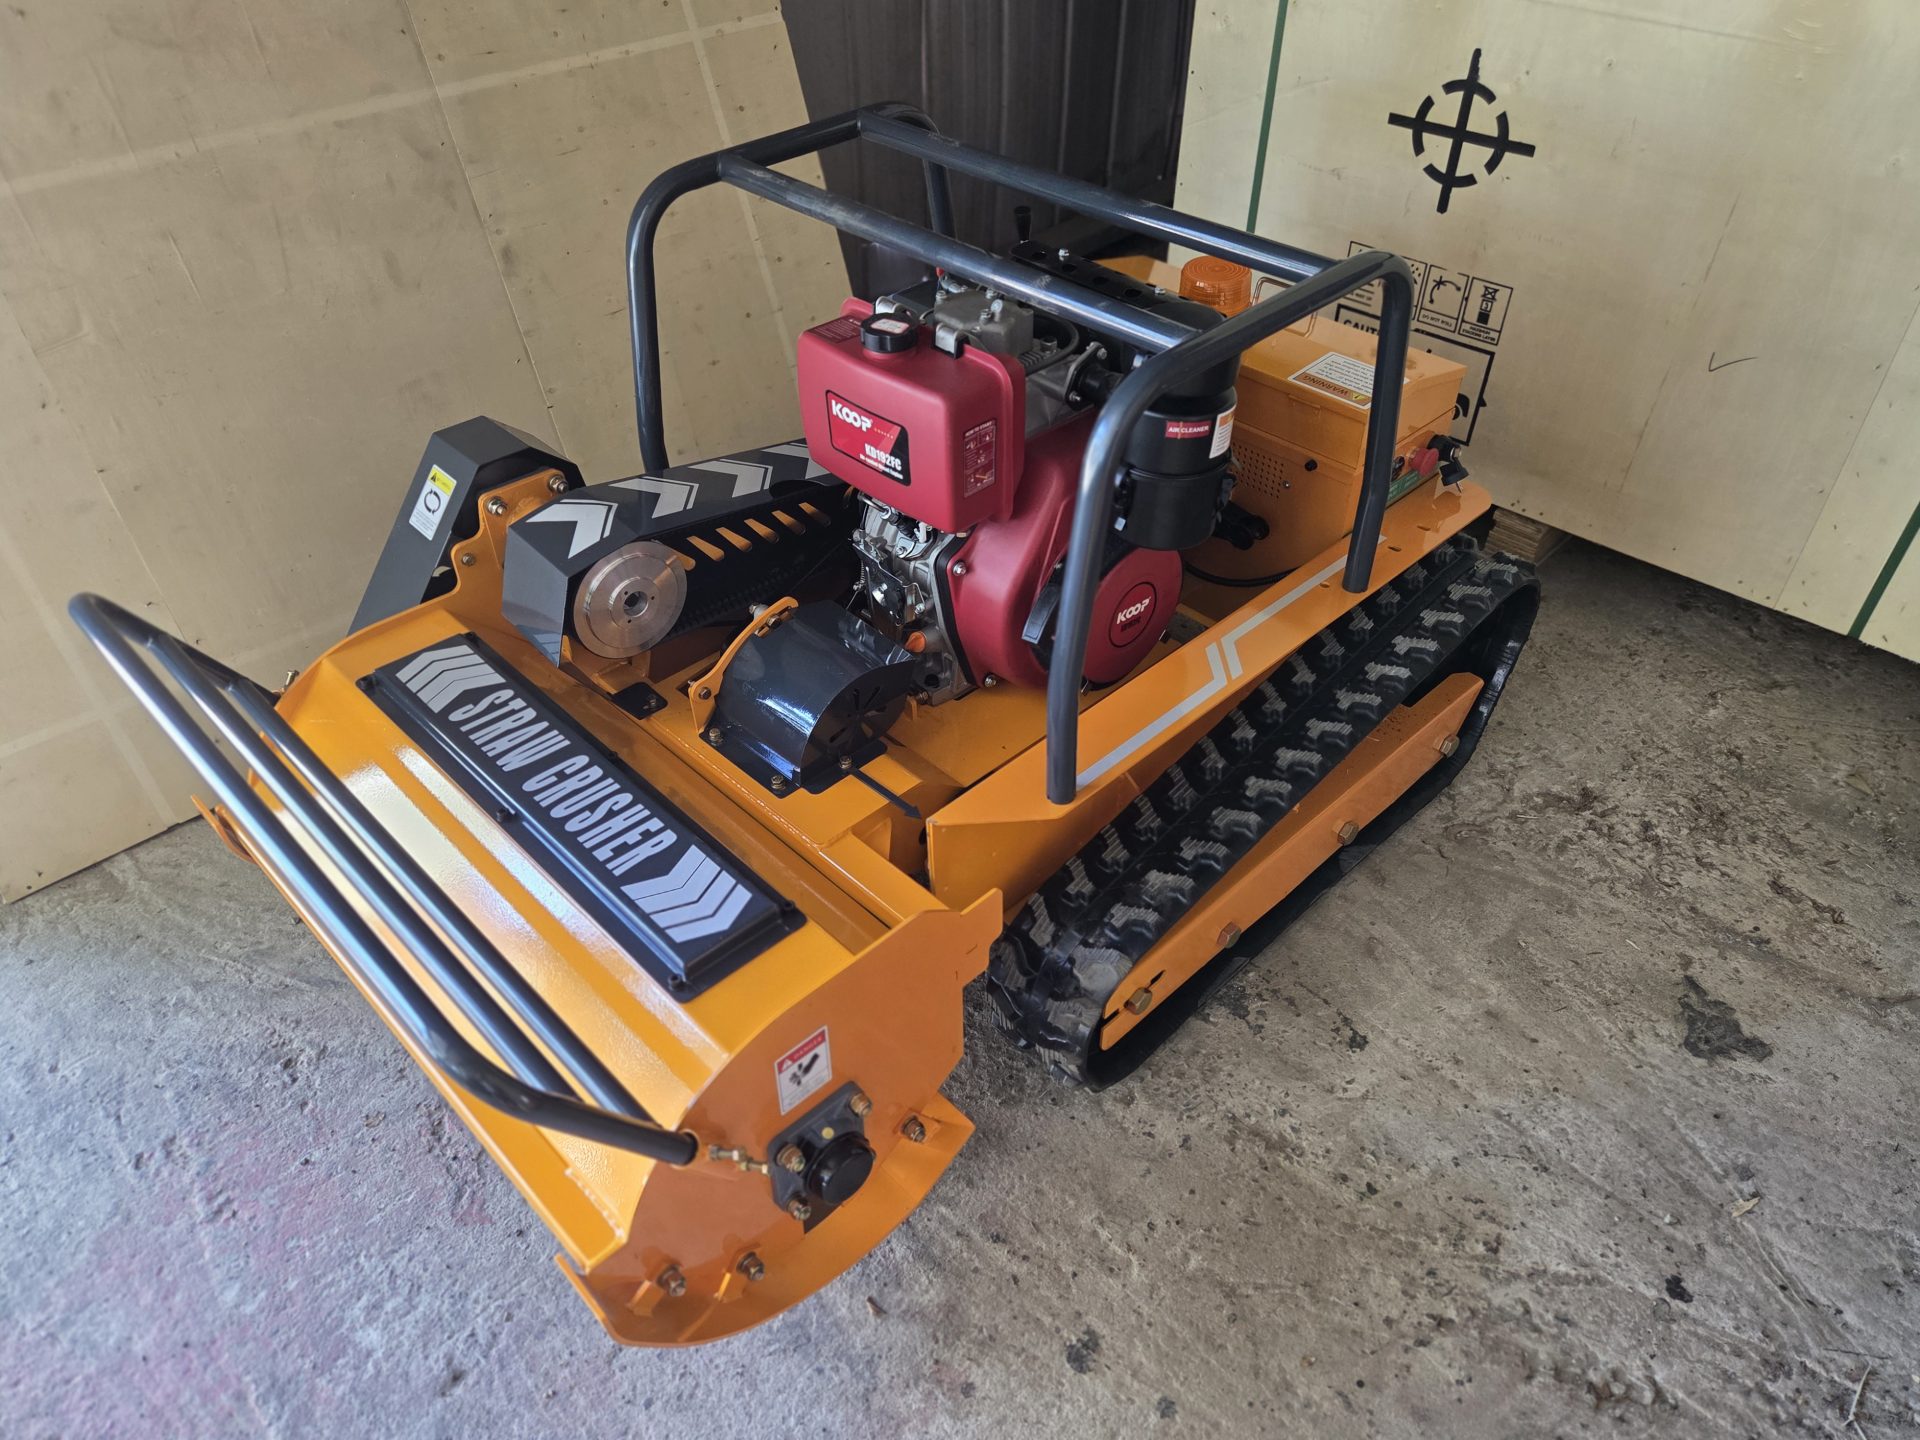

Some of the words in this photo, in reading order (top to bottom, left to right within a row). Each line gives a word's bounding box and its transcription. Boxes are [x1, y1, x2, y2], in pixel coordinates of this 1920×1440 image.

[1303, 375, 1349, 397] WARNING
[831, 399, 872, 433] KOOP
[1180, 425, 1210, 433] CLEANER
[1116, 597, 1151, 625] KOOP
[448, 689, 571, 772] STRAW
[521, 754, 678, 877] CRUSHER
